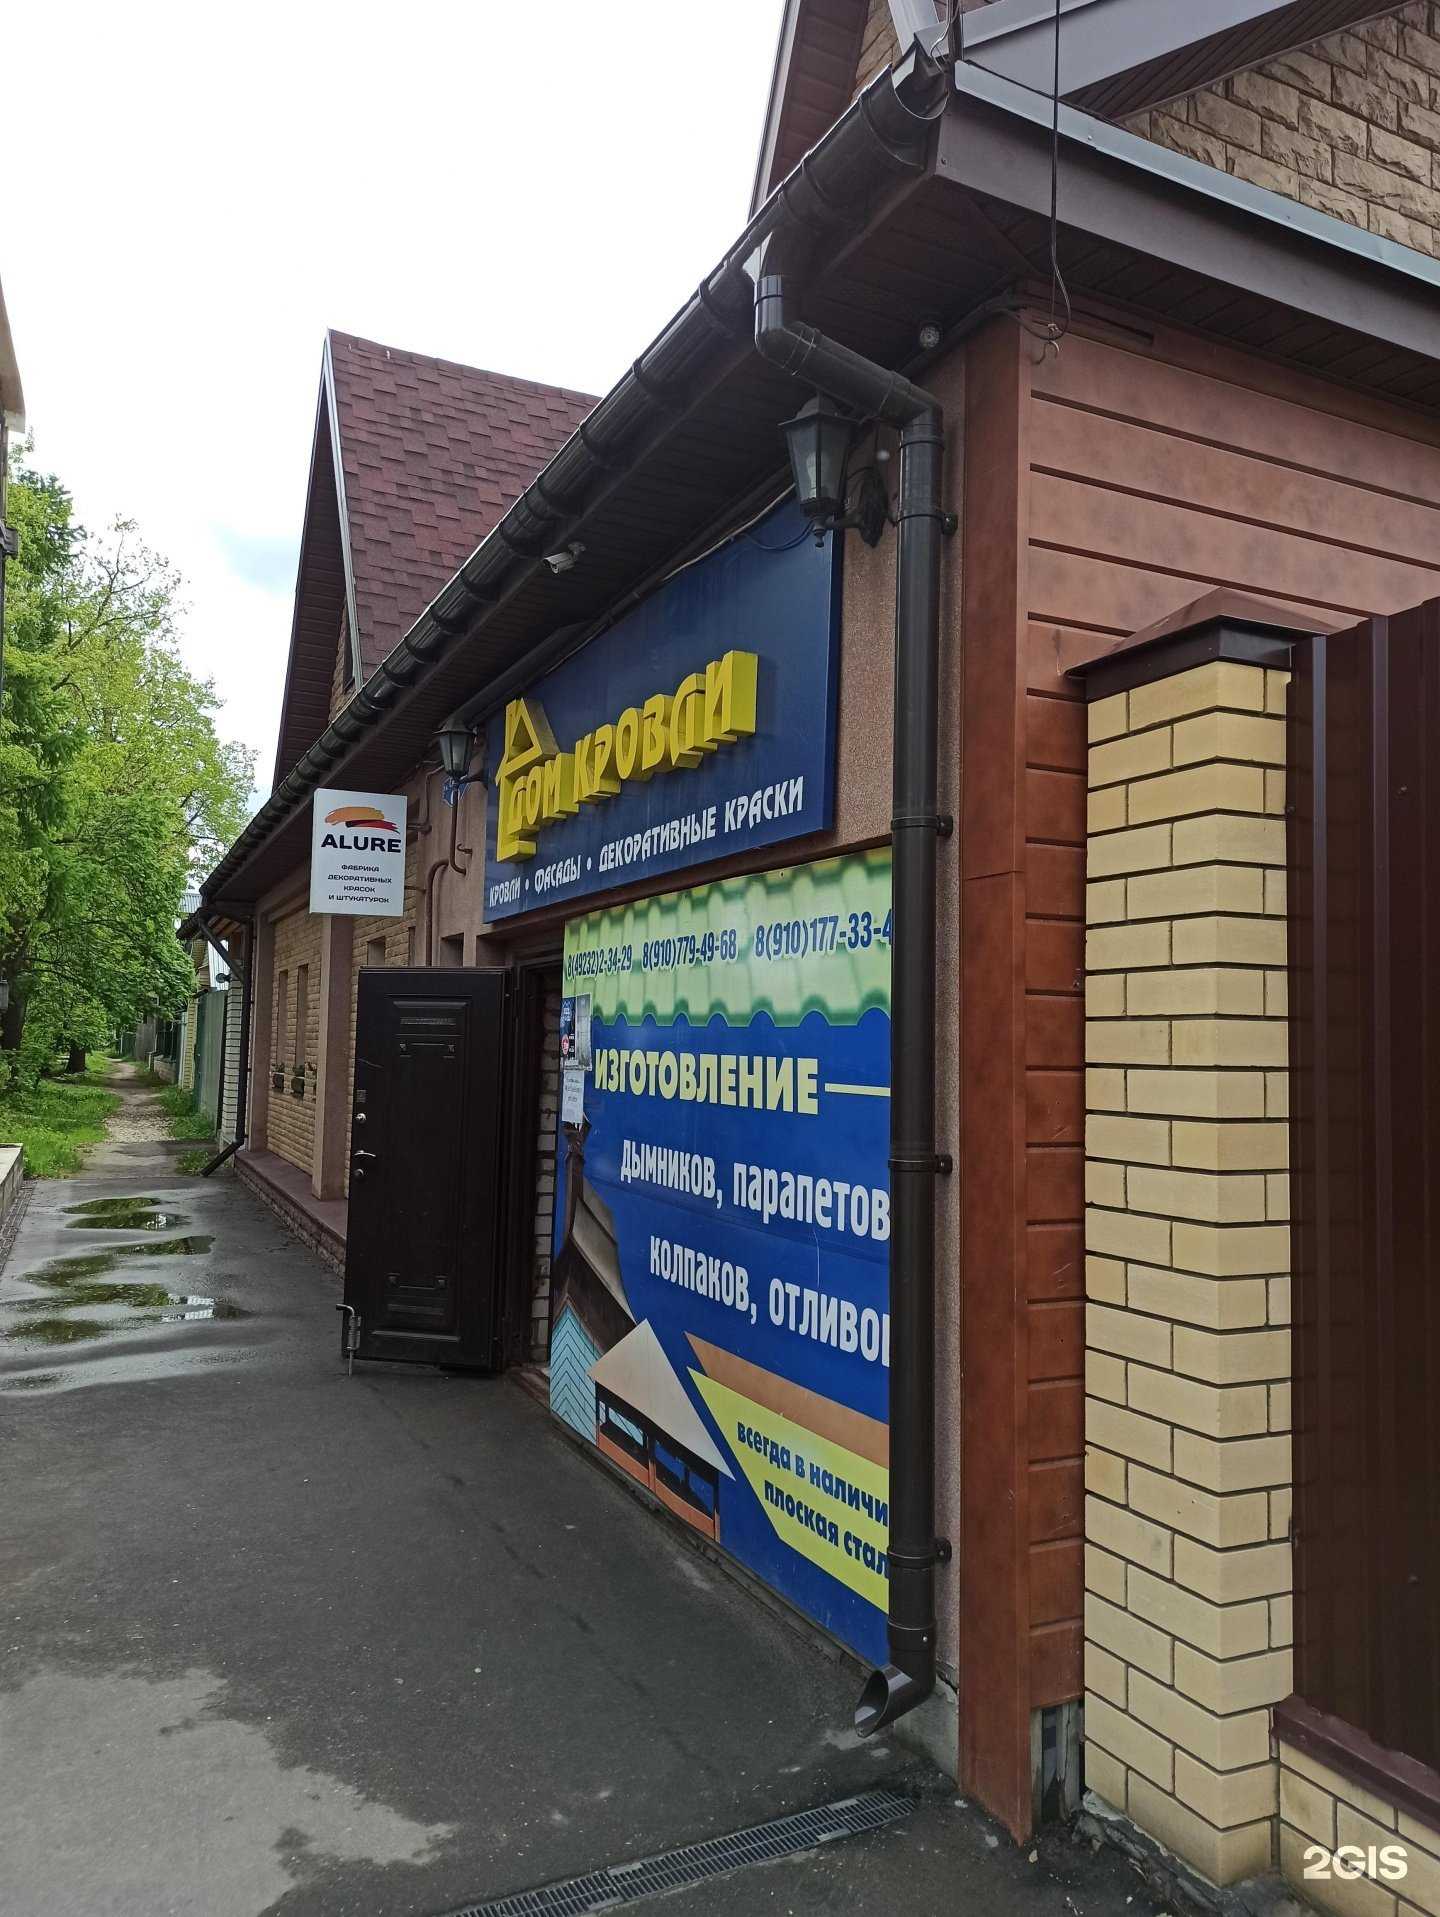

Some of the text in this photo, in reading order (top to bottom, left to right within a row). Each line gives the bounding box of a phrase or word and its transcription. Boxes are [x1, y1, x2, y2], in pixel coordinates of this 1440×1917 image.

[573, 650, 758, 805] КРОВЛИ
[321, 834, 402, 853] ALURE
[341, 864, 380, 872] ФАБРИКА
[489, 775, 804, 908] КРОВЛИ ФАСАДЫ ДЕКОРАТИВНЫЕ КРАСКИ
[327, 874, 392, 883] ДЕКОРАТИВНЫХ
[336, 896, 390, 904] ШТУКАТУРОК
[343, 885, 376, 893] КРАСОК
[566, 944, 633, 978] 8(49232)2-34-29
[642, 928, 737, 970] 8(910)779-49-68
[595, 1048, 818, 1115] ИЗГОТОВЛЕНИЕ
[650, 1235, 757, 1325] колпаков,
[737, 1421, 791, 1471] всегда
[795, 1454, 805, 1478] в
[764, 1479, 839, 1547] плоская
